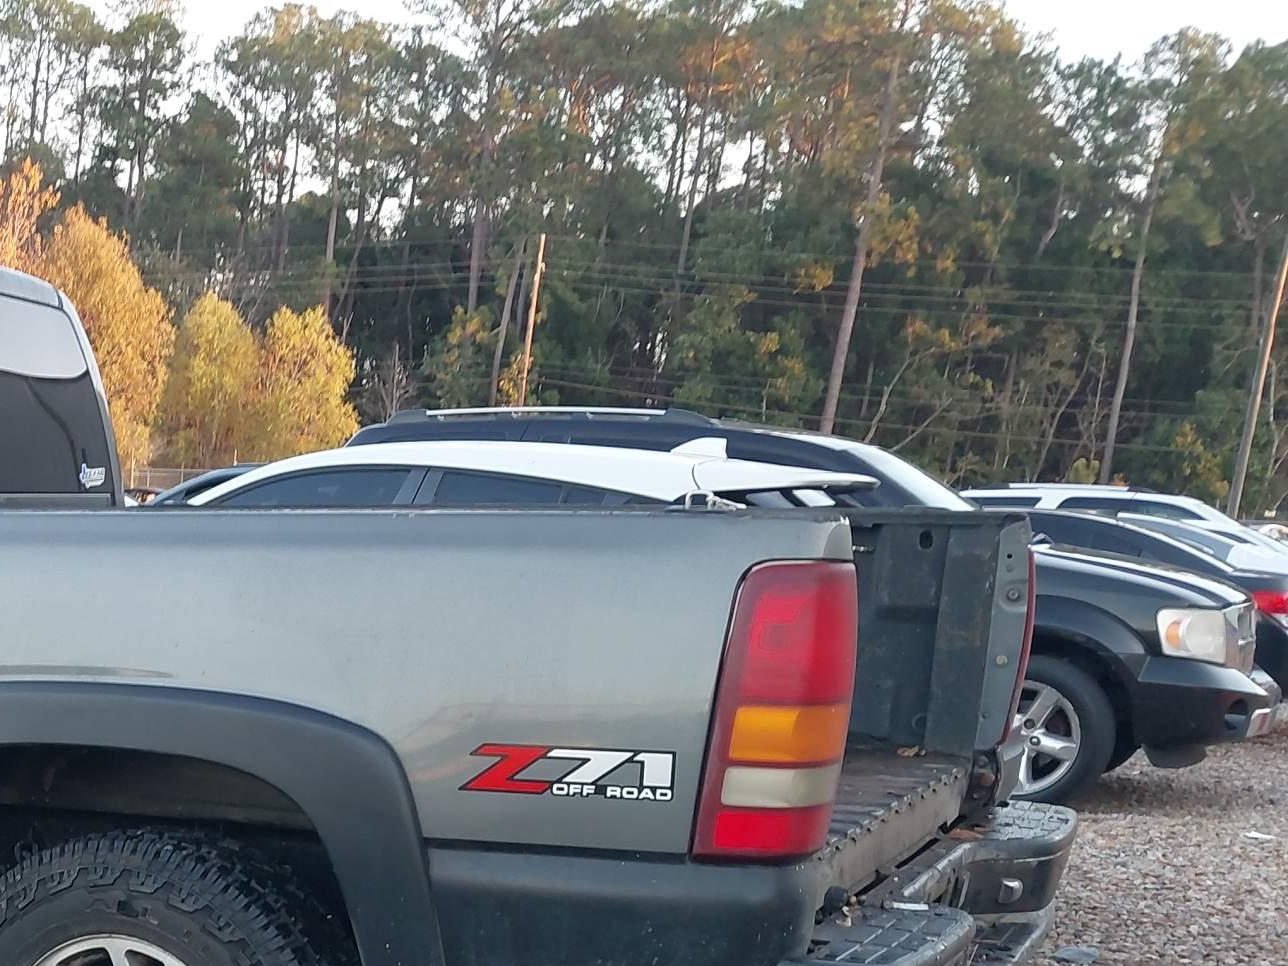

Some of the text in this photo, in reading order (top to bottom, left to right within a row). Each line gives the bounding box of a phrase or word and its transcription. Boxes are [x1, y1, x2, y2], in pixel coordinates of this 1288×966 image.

[459, 743, 676, 794] Z71
[551, 783, 673, 801] OFF ROAD
